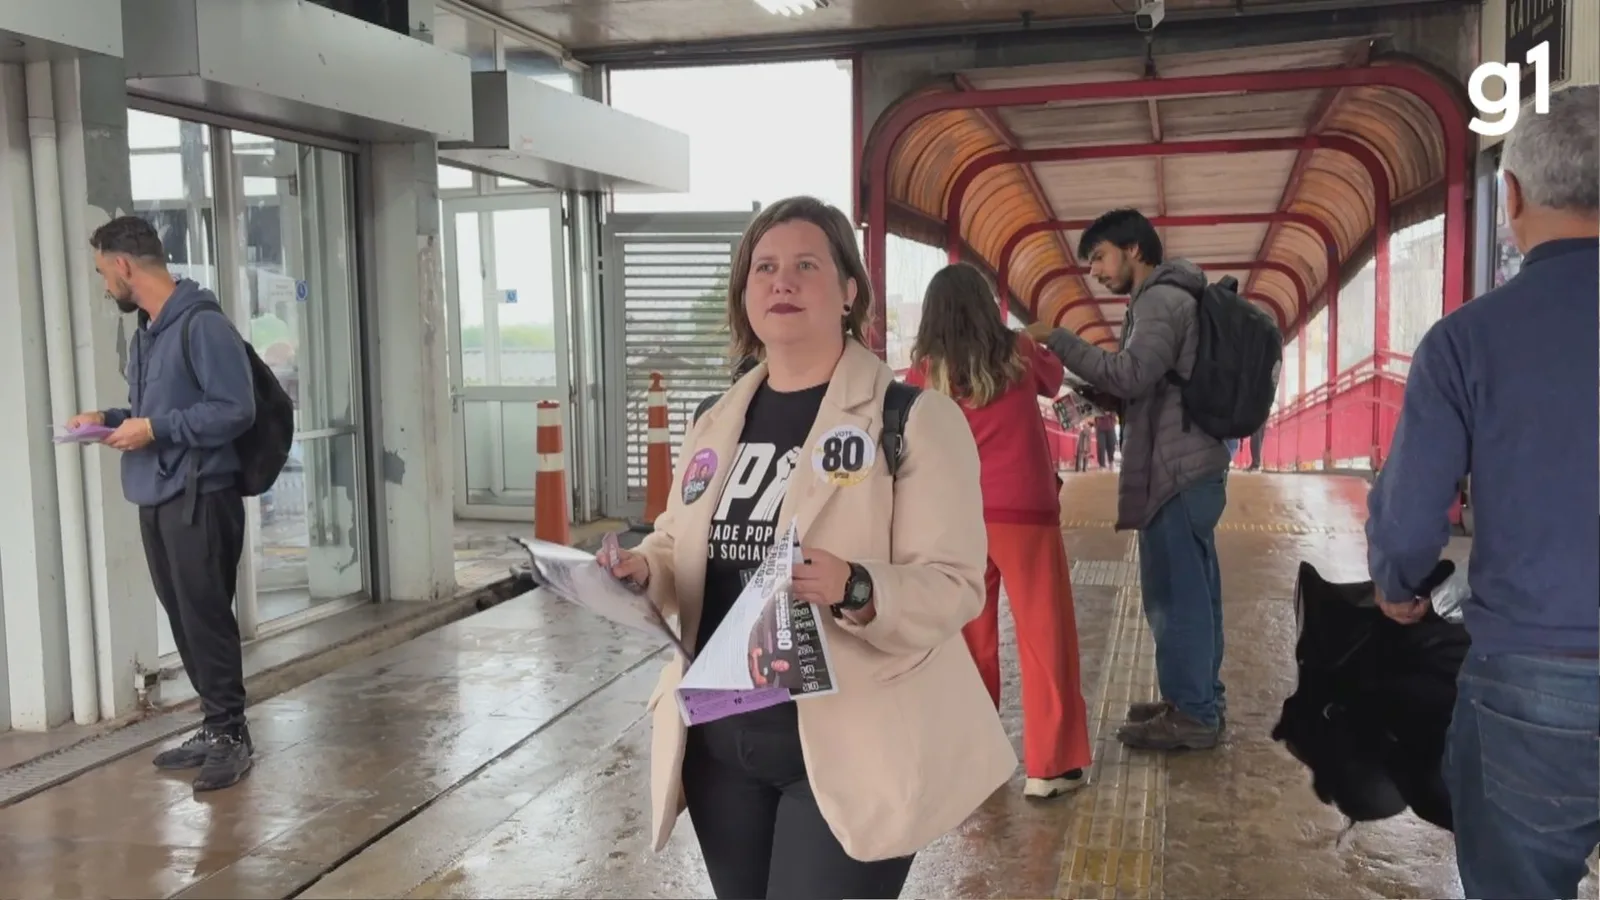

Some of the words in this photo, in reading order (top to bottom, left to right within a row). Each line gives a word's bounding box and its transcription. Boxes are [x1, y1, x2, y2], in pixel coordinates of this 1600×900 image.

[834, 430, 853, 438] VOTE
[822, 435, 865, 472] 80
[745, 524, 774, 542] POP
[776, 629, 793, 650] 80
